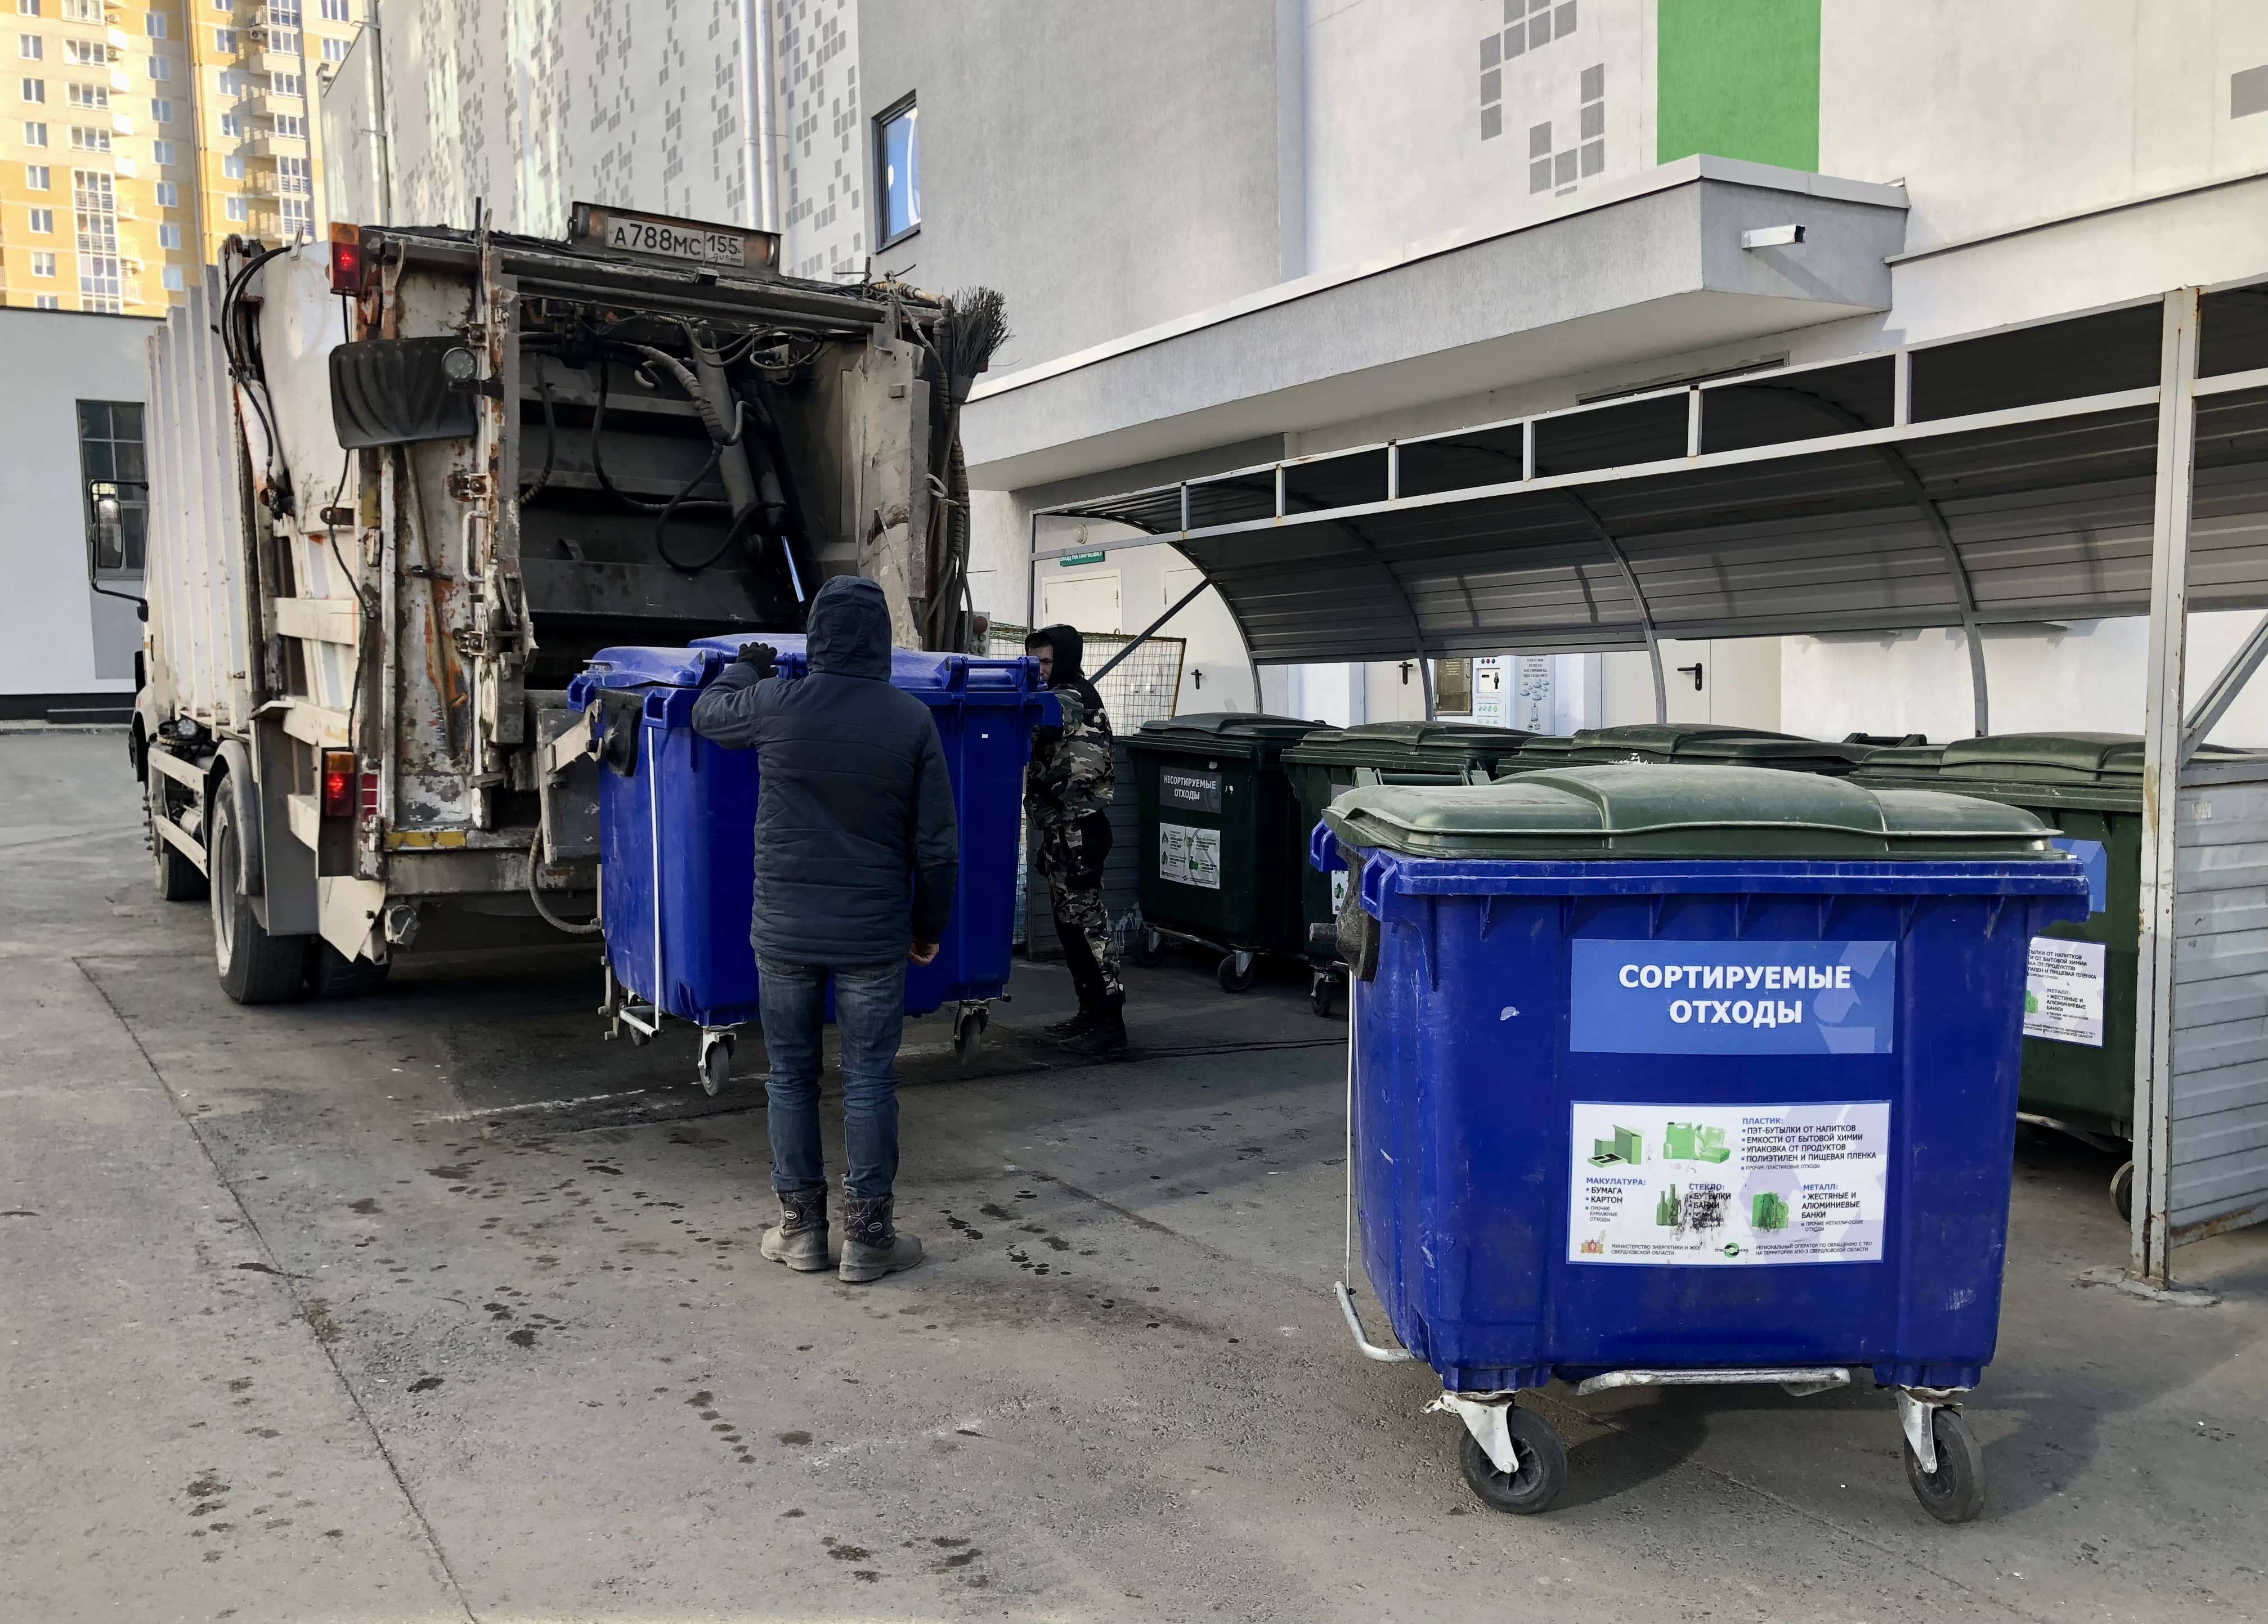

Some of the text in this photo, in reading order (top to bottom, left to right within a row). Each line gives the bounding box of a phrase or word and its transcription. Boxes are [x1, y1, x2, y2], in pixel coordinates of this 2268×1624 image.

[614, 223, 738, 255] А788МС 155
[1164, 775, 1216, 789] НЕСОРТИРУЕМЫЕ
[1174, 788, 1200, 801] ОТХОДЫ
[1619, 964, 1851, 990] СОРТИРУЕМЫЕ
[1669, 1000, 1802, 1029] ОТХОДЫ
[1798, 1133, 1835, 1142] БЫТОВОЙ
[1801, 1143, 1846, 1152] ПРОДУКТОВ
[1808, 1153, 1844, 1161] ПИЩЕВАЯ
[1586, 1177, 1646, 1186] МАКУЛАТУРА:
[1801, 1201, 1861, 1209] АЛЮМИНИЕВЫЕ
